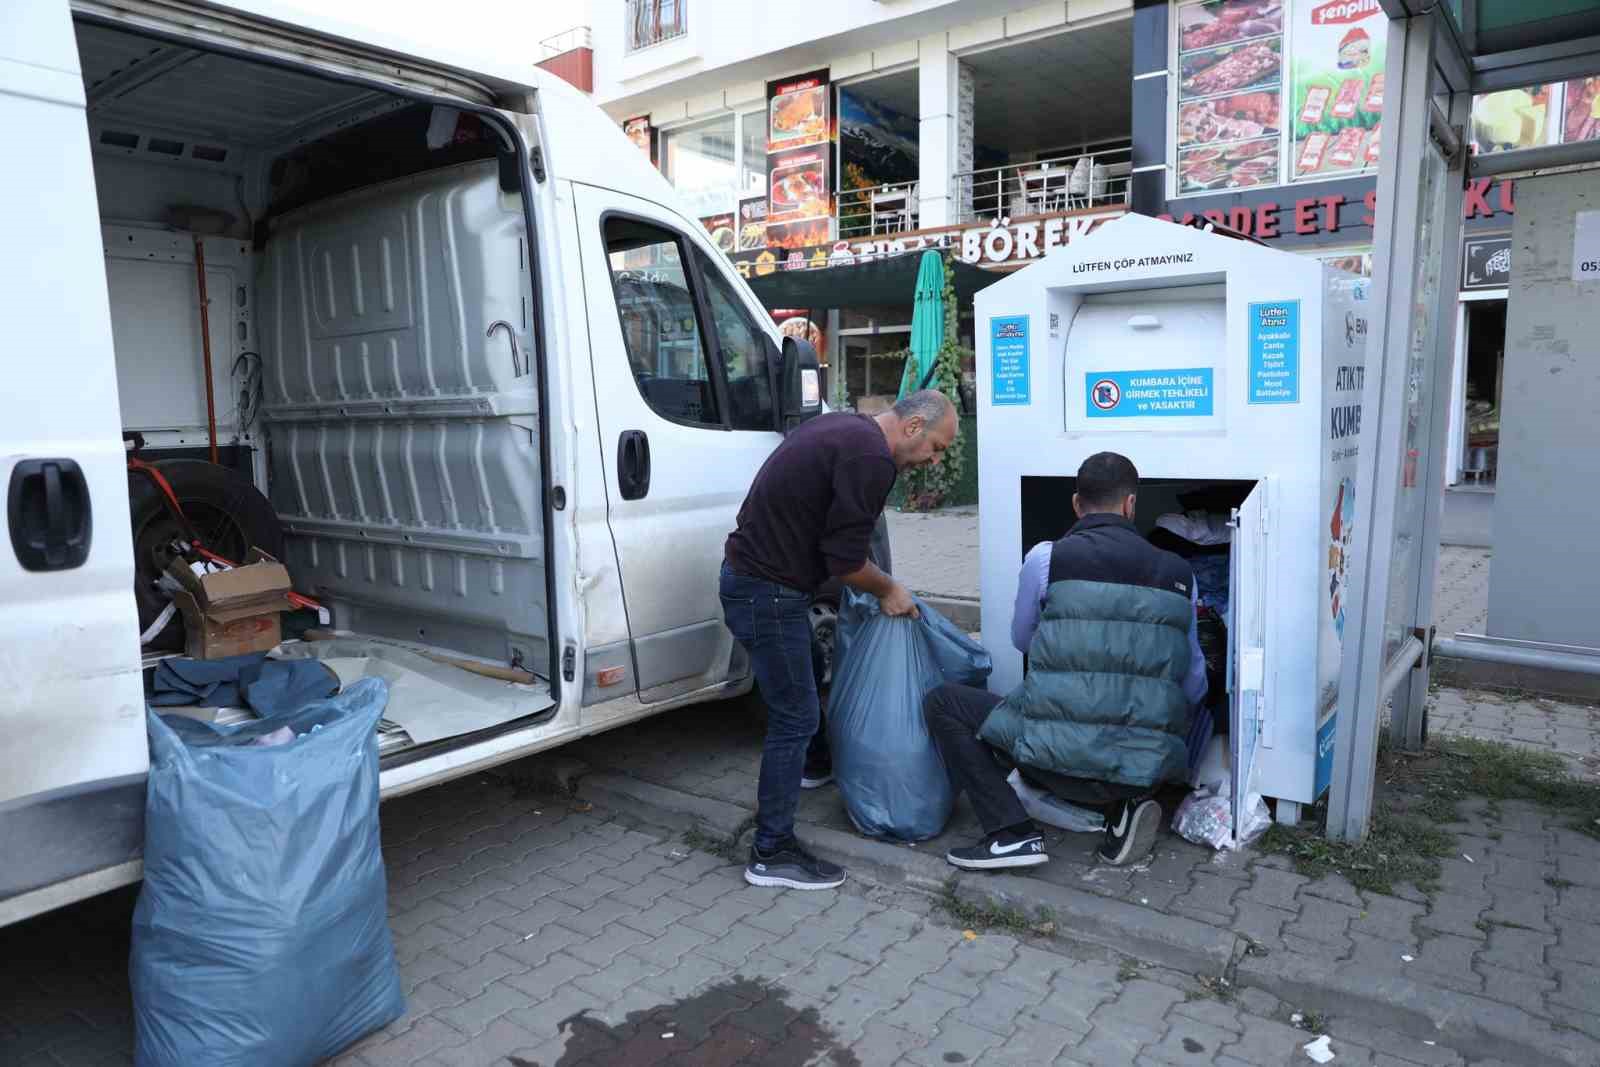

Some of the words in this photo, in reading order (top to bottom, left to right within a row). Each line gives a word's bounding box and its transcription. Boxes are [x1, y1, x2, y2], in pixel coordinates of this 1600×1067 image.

[1295, 195, 1344, 233] ET
[1072, 261, 1112, 274] LÜTFEN
[1113, 257, 1136, 270] ÇÖP
[1137, 253, 1193, 267] ATMAYINIZ
[1581, 261, 1600, 271] 05
[1130, 376, 1176, 387] KUMBARA
[1336, 366, 1355, 391] ATIK
[1126, 389, 1161, 400] GİRMEK
[1163, 386, 1208, 398] TEHLİKELİ
